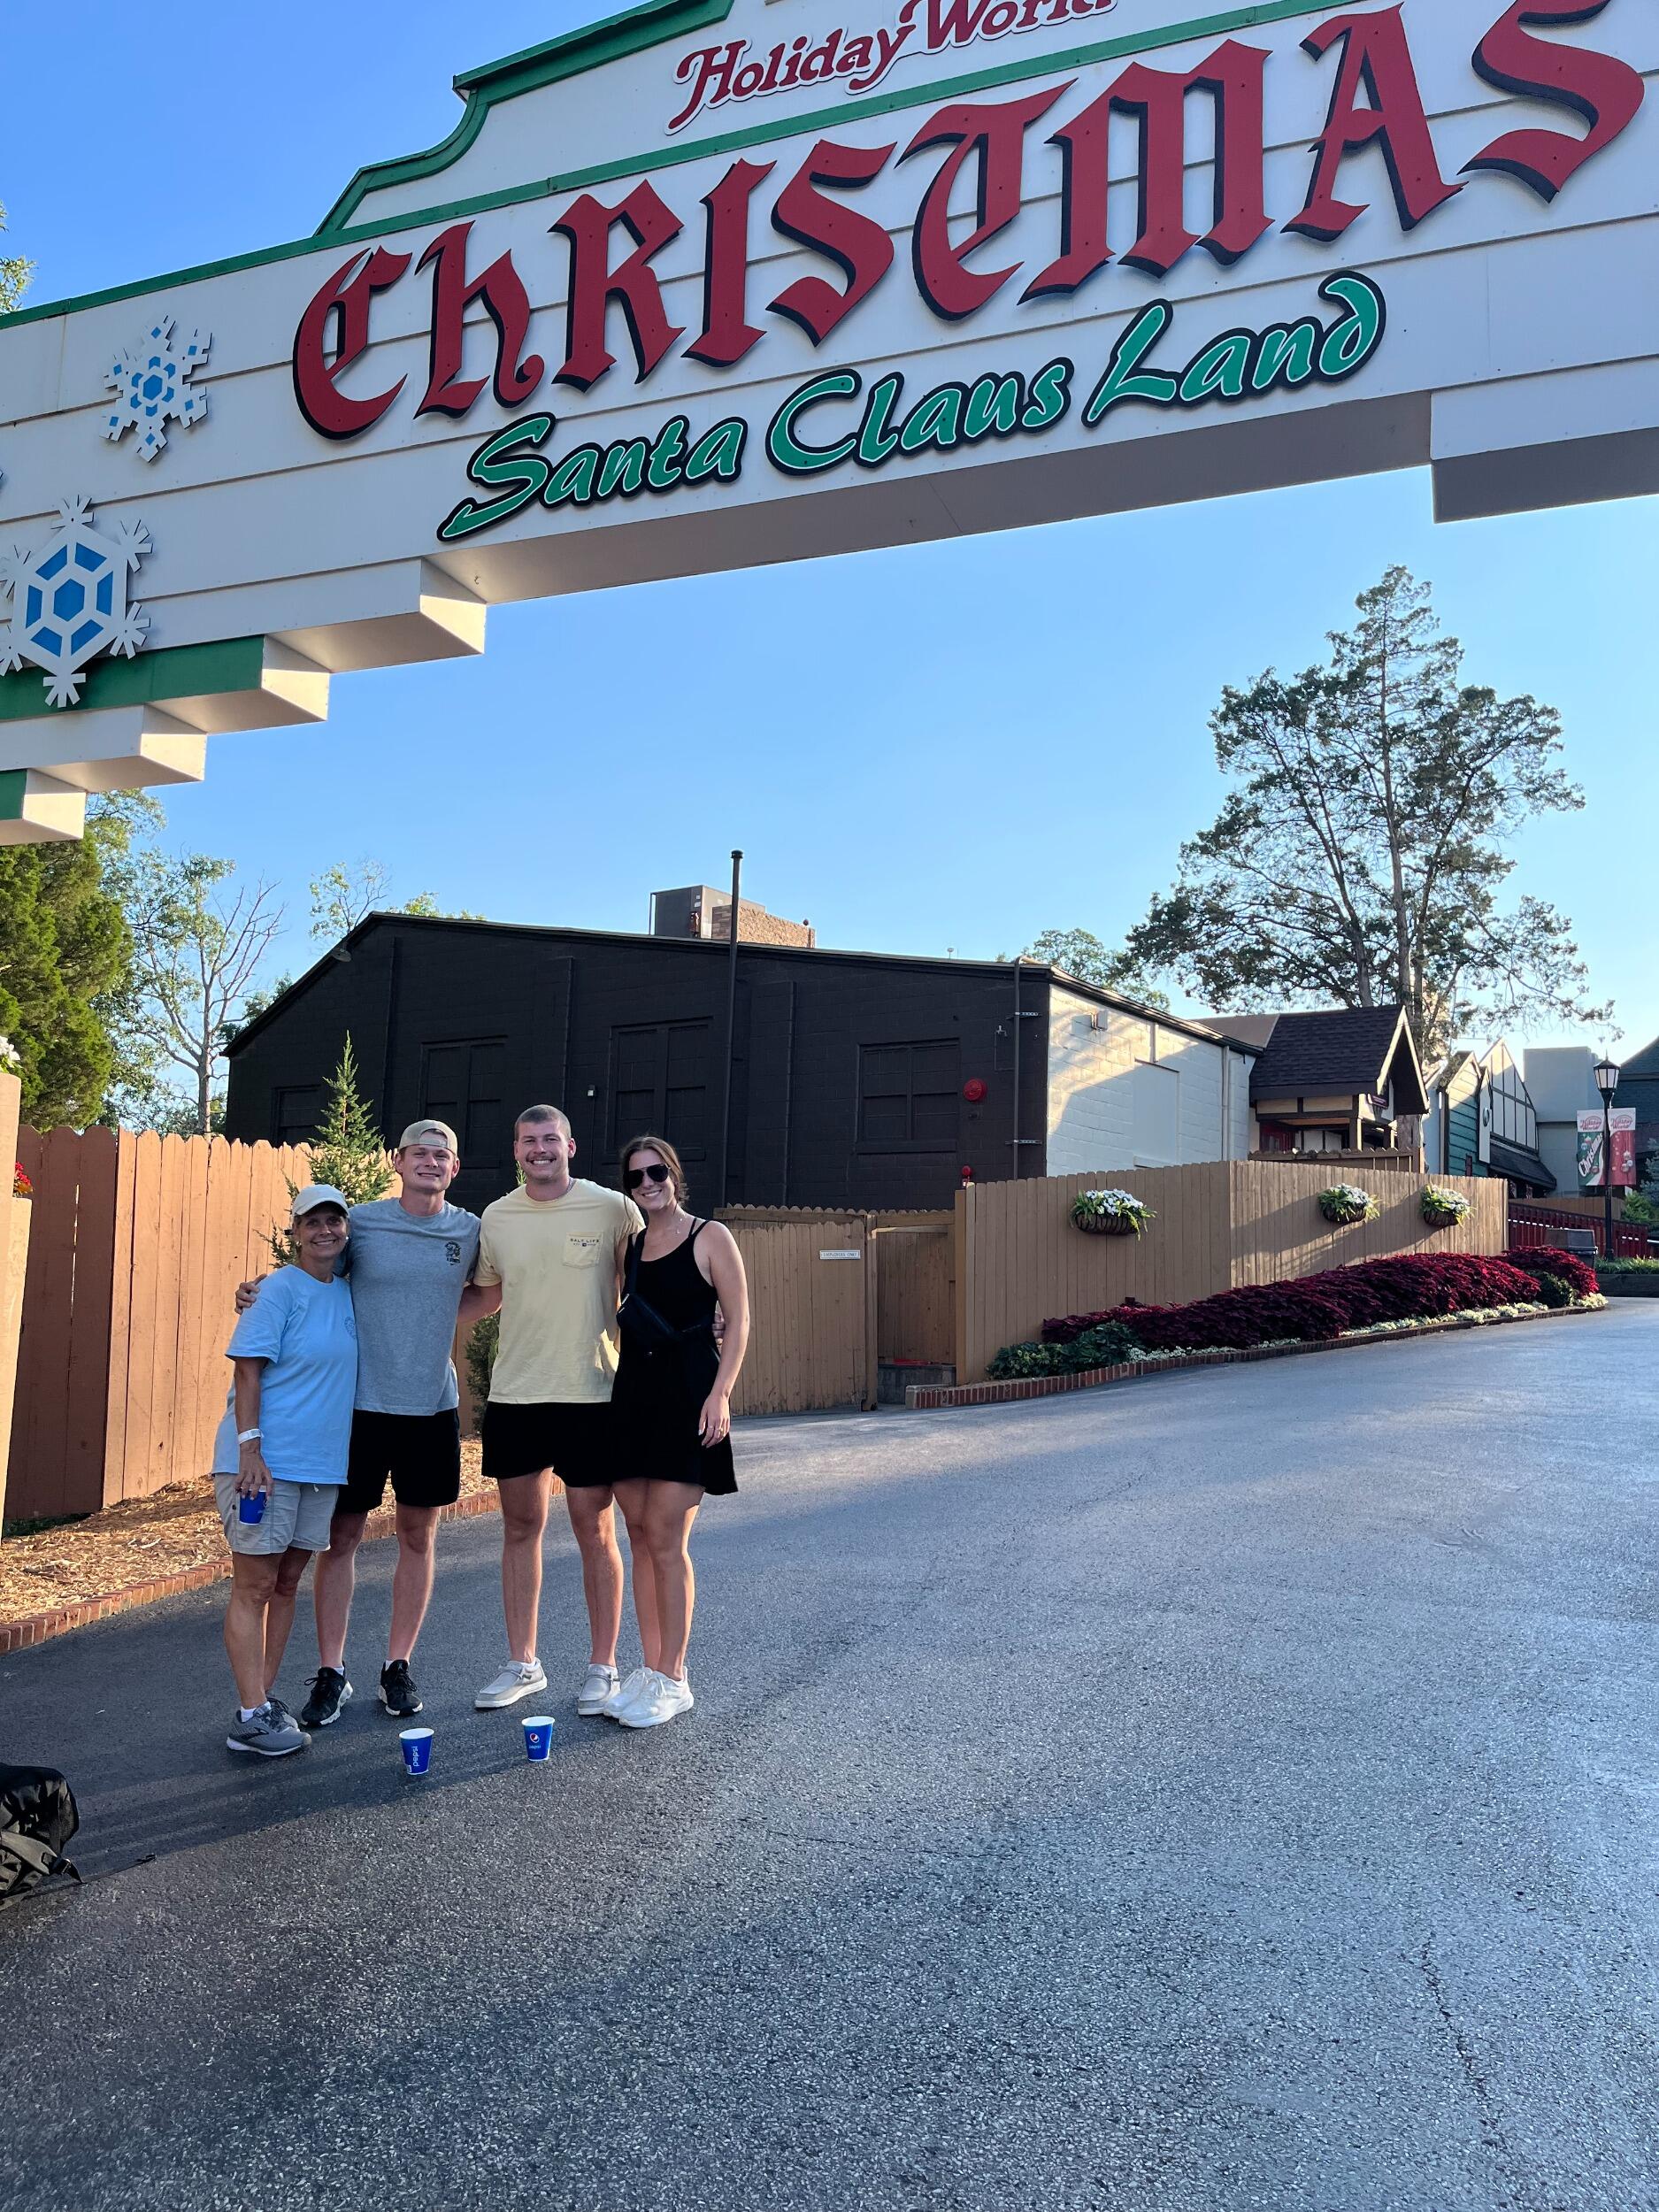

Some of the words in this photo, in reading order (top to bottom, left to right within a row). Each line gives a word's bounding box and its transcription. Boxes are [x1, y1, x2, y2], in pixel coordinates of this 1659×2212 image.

[667, 25, 917, 131] Holiday
[437, 411, 748, 541] Santa
[765, 357, 1073, 478] Claus
[1081, 271, 1386, 428] Land
[411, 1746, 420, 1767] pepsi
